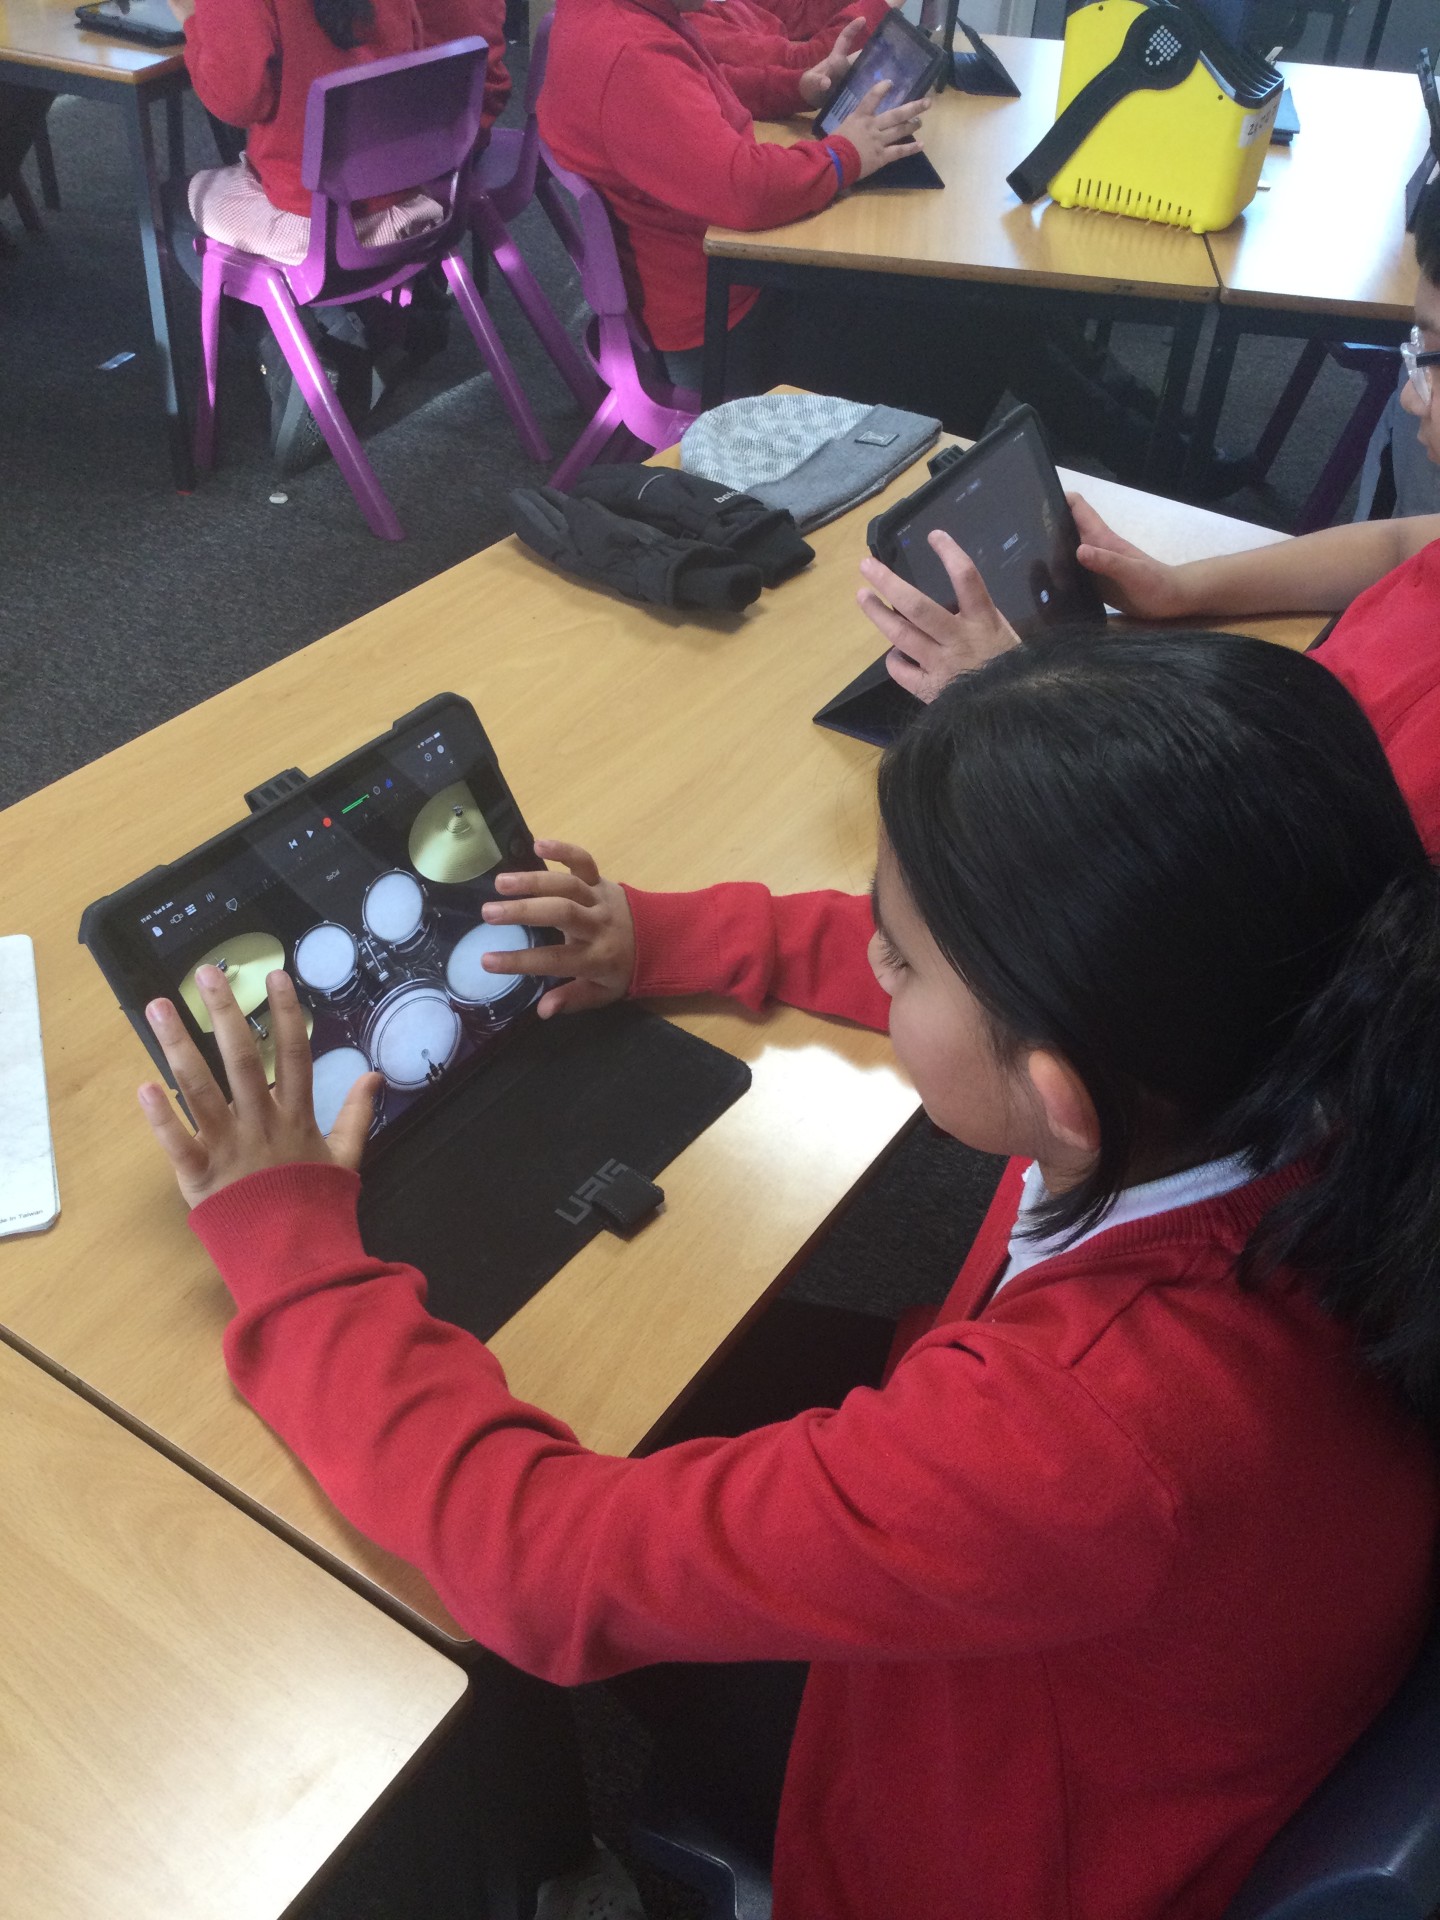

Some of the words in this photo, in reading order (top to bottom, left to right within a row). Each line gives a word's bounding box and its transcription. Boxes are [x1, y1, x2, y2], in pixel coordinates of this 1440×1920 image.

[153, 908, 162, 916] Tue
[554, 1158, 630, 1225] UAG
[18, 1209, 44, 1219] Taiwan
